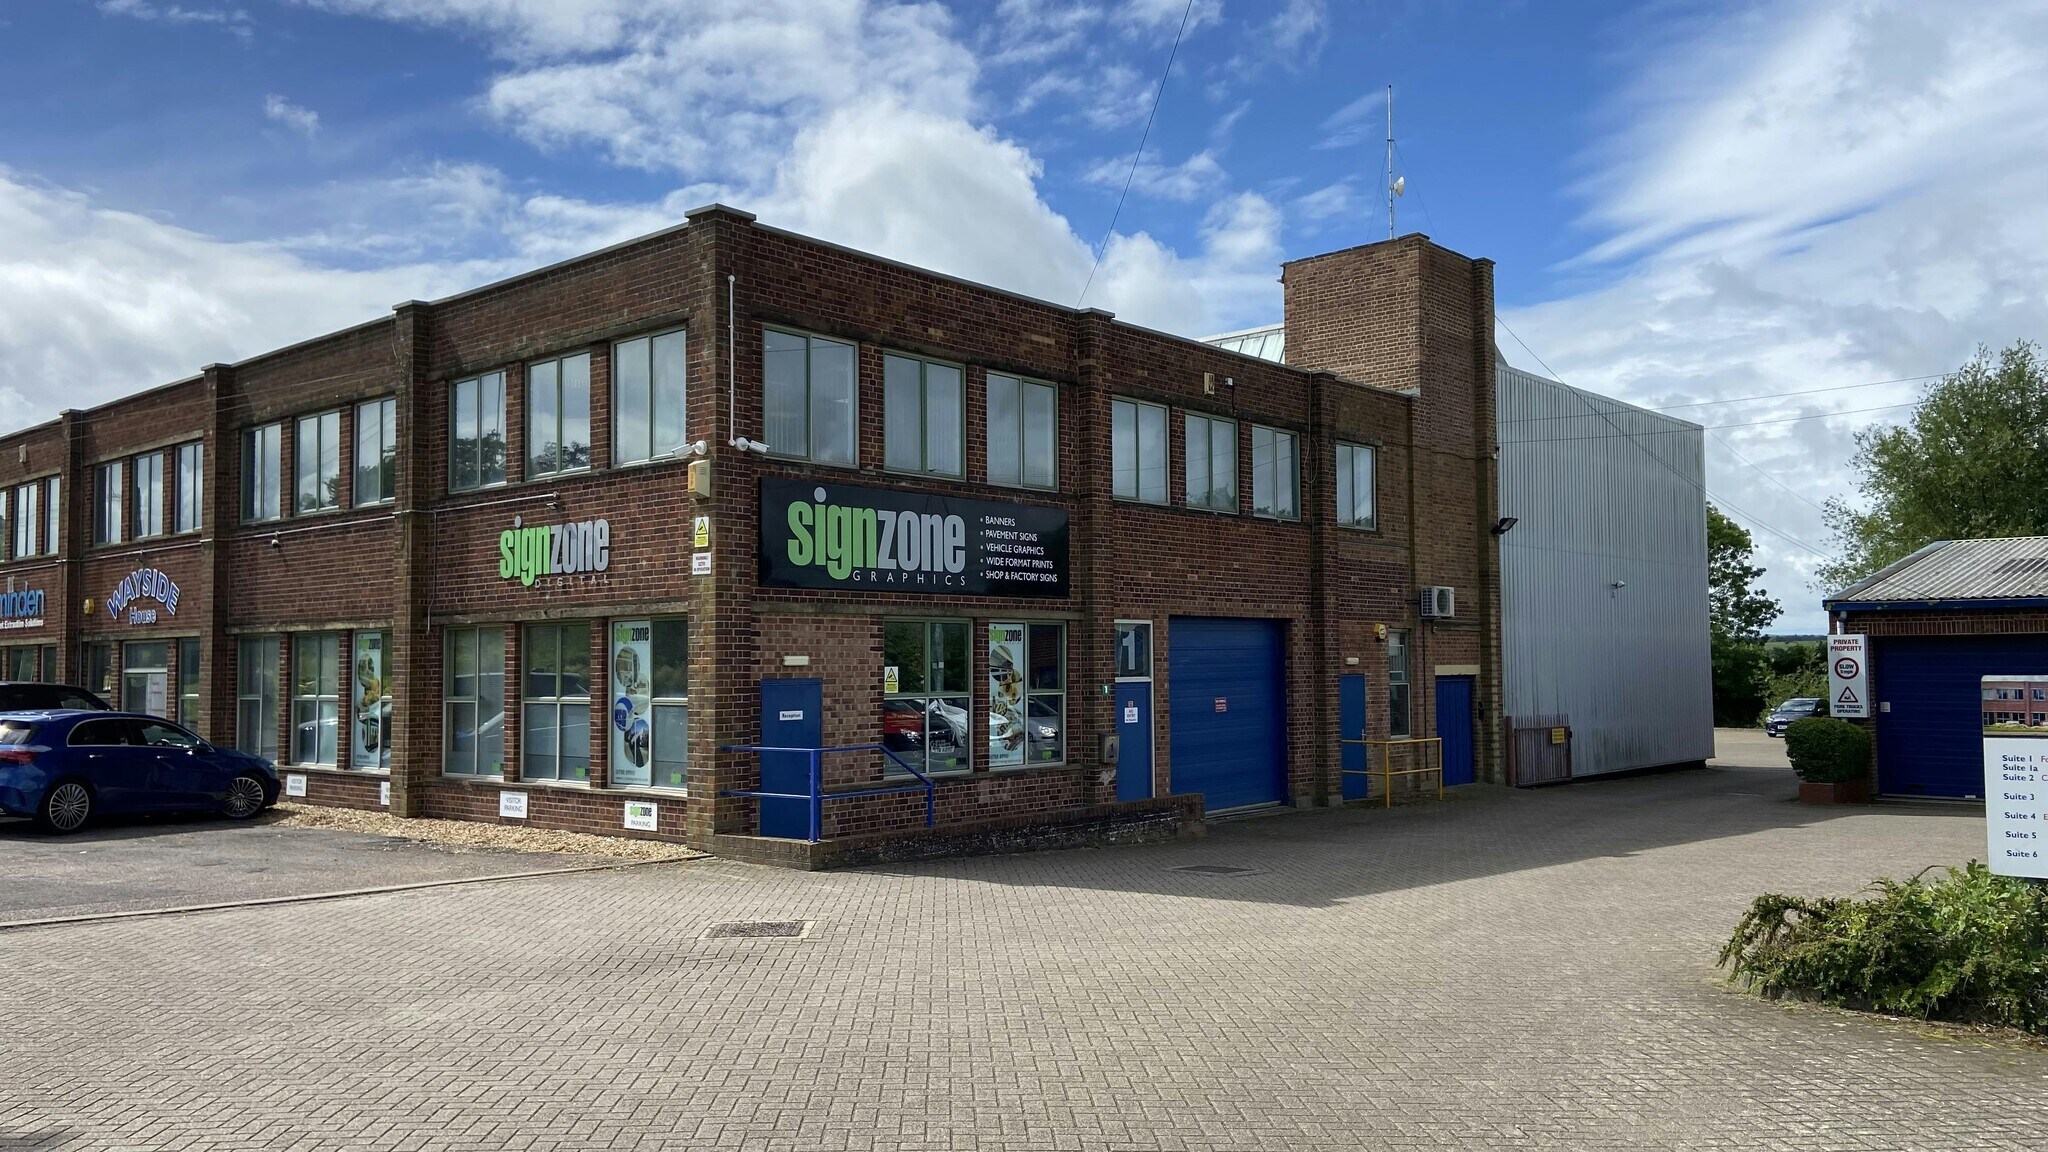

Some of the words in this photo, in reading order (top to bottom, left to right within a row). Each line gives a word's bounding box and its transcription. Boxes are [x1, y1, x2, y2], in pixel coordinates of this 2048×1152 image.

[985, 515, 1016, 527] BANNERS
[787, 486, 966, 580] signzone
[985, 529, 1019, 540] PAVEMENT
[1019, 532, 1038, 542] SIGNS
[499, 515, 610, 587] signzone
[985, 543, 1013, 553] VEHICLE
[1013, 545, 1045, 556] GRAPHICS
[985, 557, 1004, 566] WIDE
[1005, 558, 1031, 568] FORMAT
[1031, 559, 1054, 569] PRINTS
[534, 574, 610, 588] DIGITAL
[852, 570, 966, 586] GRAPHICS
[985, 570, 1004, 580] SHOP
[1004, 571, 1010, 580] &
[1010, 571, 1039, 581] FACTORY
[1039, 573, 1058, 583] SIGNS
[107, 568, 180, 620] WAYSIDE
[129, 606, 157, 625] House
[1122, 630, 1136, 670] 1
[1104, 685, 1108, 694] 1
[2002, 755, 2026, 763] Suite
[2002, 764, 2026, 772] Suite
[2002, 773, 2027, 782] Suite
[2029, 774, 2034, 782] 2
[2003, 792, 2027, 801] Suite
[2029, 793, 2035, 801] 3
[504, 804, 523, 812] PARKING
[2004, 811, 2028, 820] Suite
[630, 819, 651, 828] PARKING
[2005, 831, 2029, 839] Suite
[2006, 850, 2030, 858] Suite
